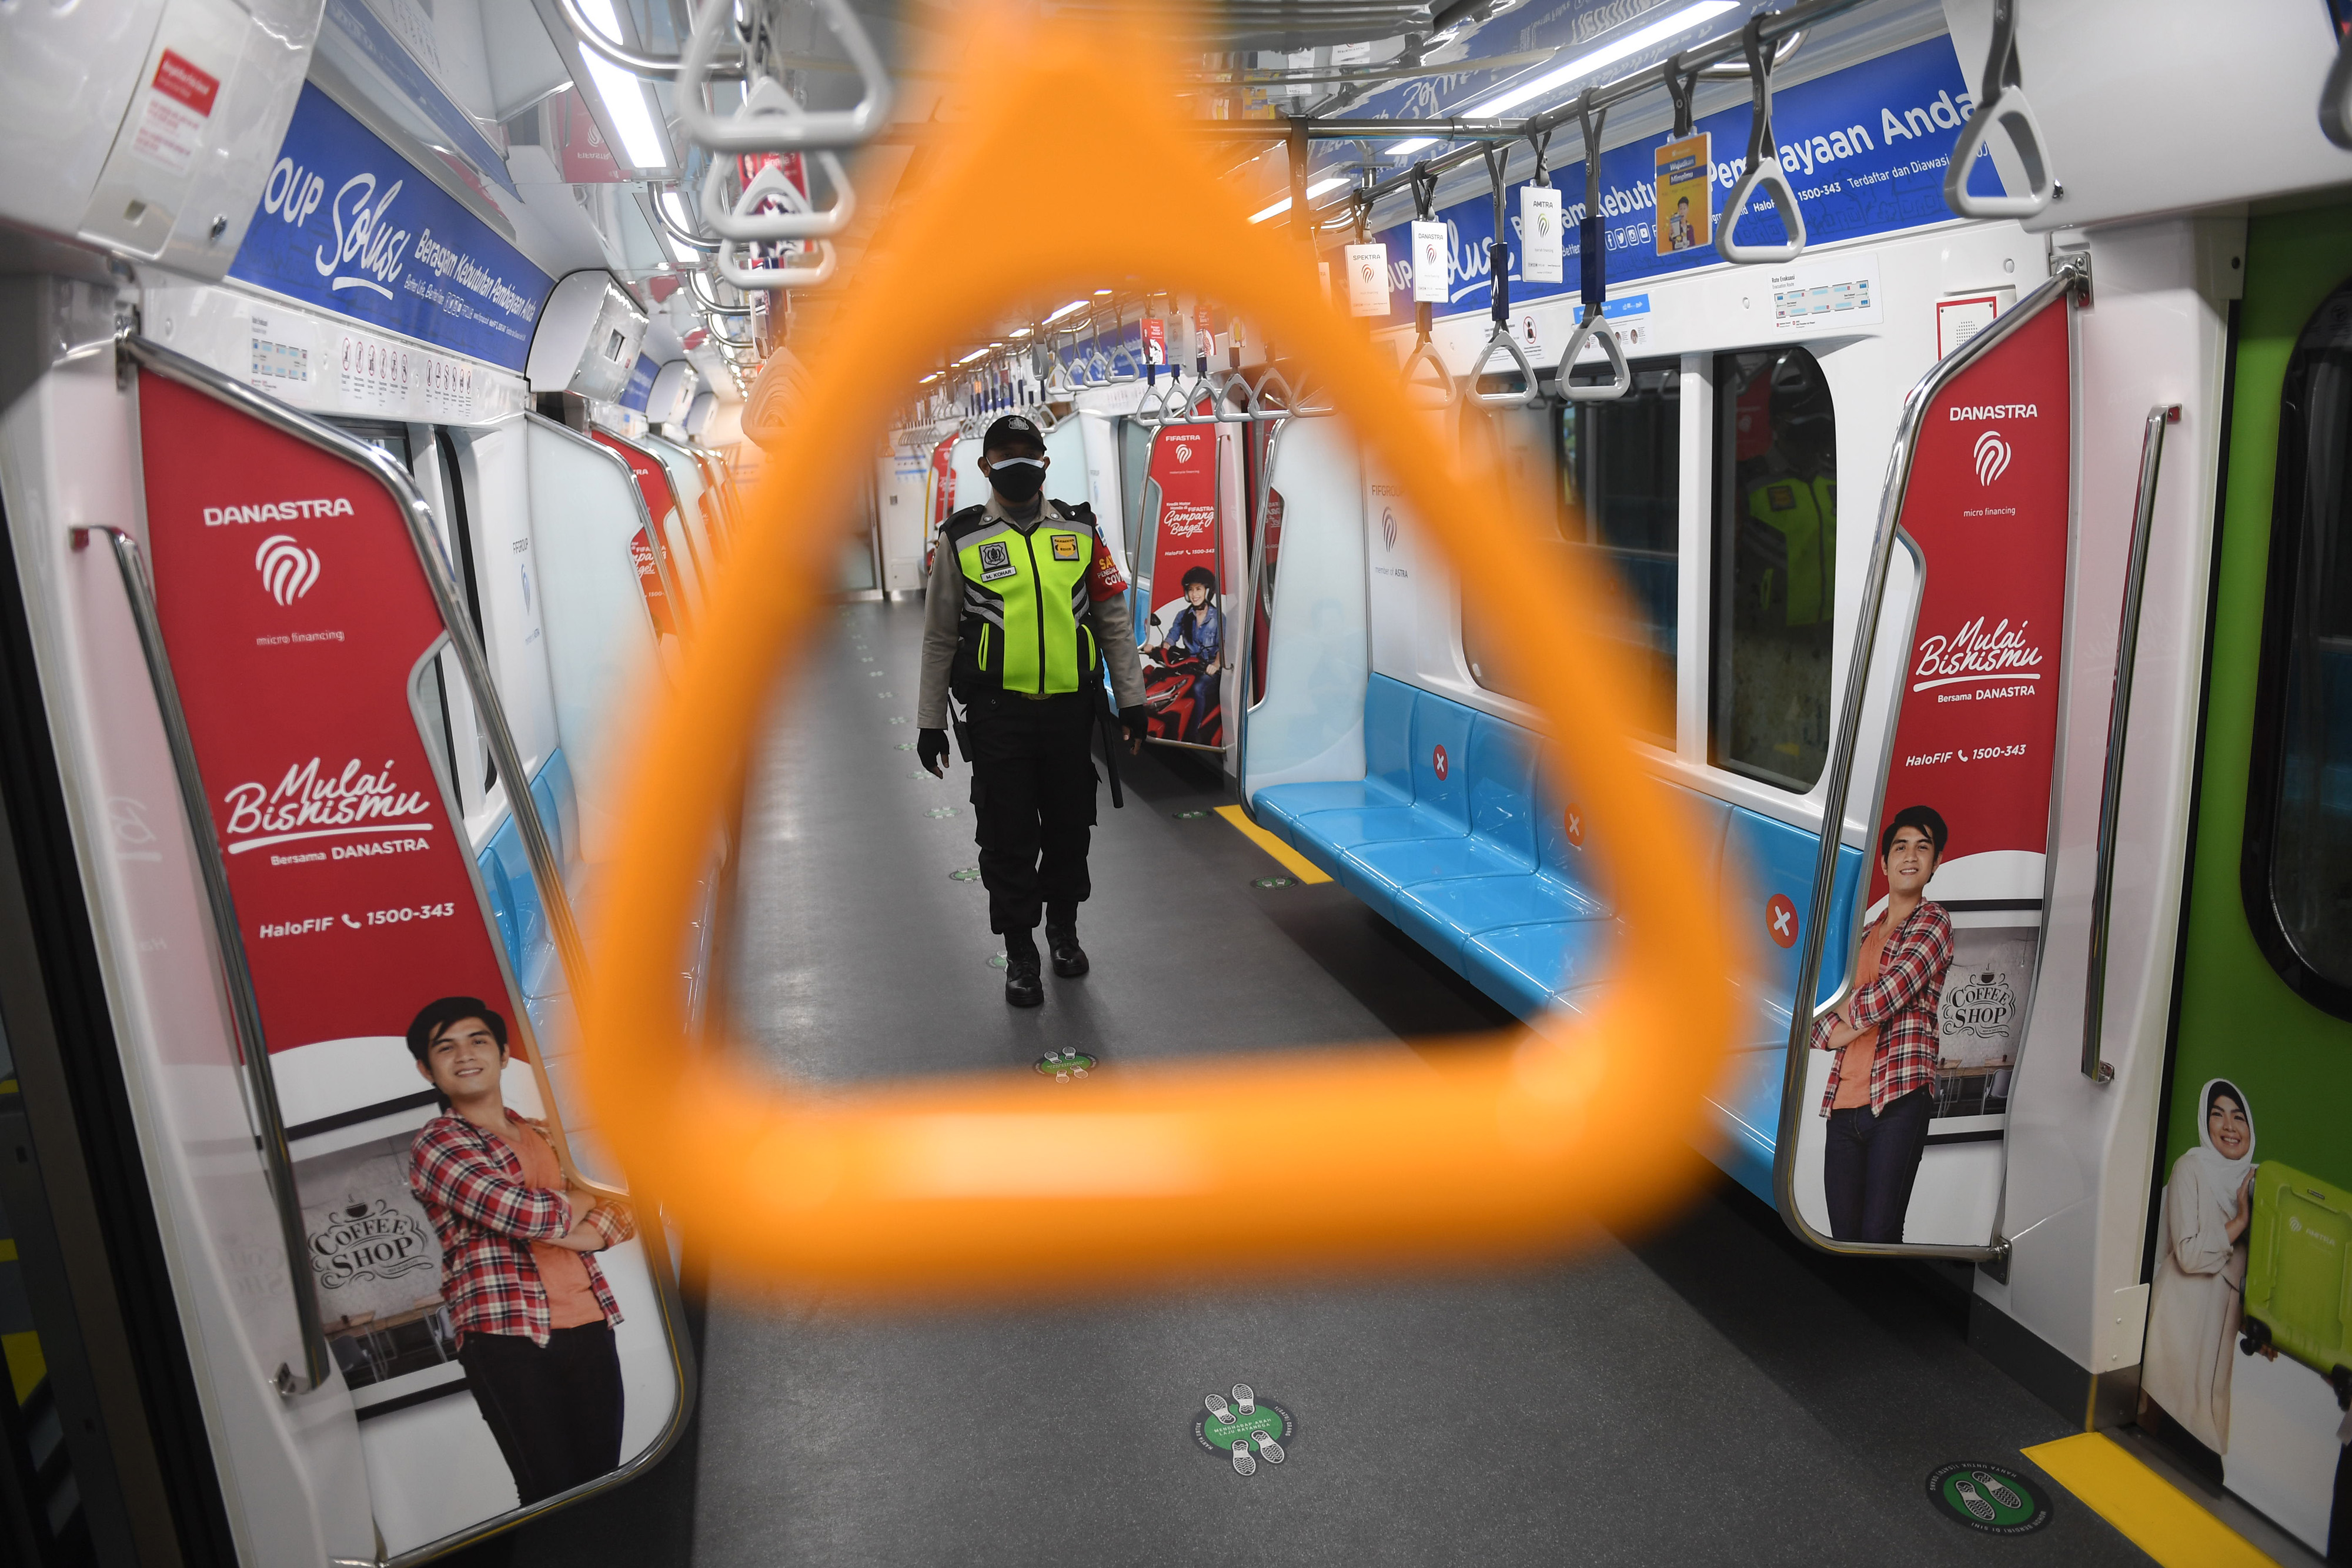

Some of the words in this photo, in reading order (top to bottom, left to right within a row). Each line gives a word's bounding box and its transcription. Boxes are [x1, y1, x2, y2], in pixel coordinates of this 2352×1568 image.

[1882, 90, 1975, 145] Anda
[1669, 159, 1694, 171] Wujudkan
[1671, 172, 1693, 182] Mimpimu
[1798, 182, 1841, 201] 1500-343
[1847, 171, 1889, 189] Terdaftar
[1892, 166, 1910, 178] dan
[1910, 153, 1950, 173] Diawasi
[315, 173, 411, 283] Solusi
[1562, 244, 1581, 257] Better
[415, 228, 458, 277] Beragam
[453, 253, 494, 300] Kebutuhan
[490, 277, 526, 316] Pembiayaan
[1950, 404, 2037, 421] DANASTRA
[203, 498, 354, 526] DANASTRA
[1164, 510, 1214, 527] Gampang
[1984, 505, 2016, 517] financing
[1170, 521, 1203, 538] Banget
[1375, 566, 1389, 574] member
[1395, 569, 1408, 579] ASTRA
[256, 633, 290, 646] micro
[292, 630, 345, 644] financing
[1948, 616, 2028, 652] Mulai
[1915, 635, 2042, 677] Bisnismu
[1937, 692, 1972, 703] Bersama
[1976, 685, 2035, 701] DANASTRA
[1906, 751, 1953, 767] HaloFIF
[1972, 744, 2026, 760] 1500-343
[270, 757, 397, 804] Mulai
[224, 782, 430, 834] Bisnismu
[271, 851, 327, 865] Bersama
[332, 837, 430, 860] DANASTRA
[259, 916, 333, 938] HaloFIF
[367, 902, 455, 926] 1500-343
[1952, 988, 2010, 1008] COFFEE
[1953, 1007, 2007, 1028] SHOP
[315, 1218, 407, 1255] COFFEE
[2306, 1228, 2336, 1246] AMITRA
[332, 1237, 412, 1278] SHOP
[1214, 1422, 1252, 1433] MENGHADAP
[1237, 1423, 1271, 1433] RATANGGA
[1198, 1436, 1214, 1450] HANYA
[1991, 1466, 2017, 1478] HANYA
[1930, 1475, 1939, 1491] ORANG
[1972, 1522, 1989, 1531] SINI
[2033, 1510, 2046, 1526] MOHON
[2004, 1524, 2033, 1533] BERDIRI
